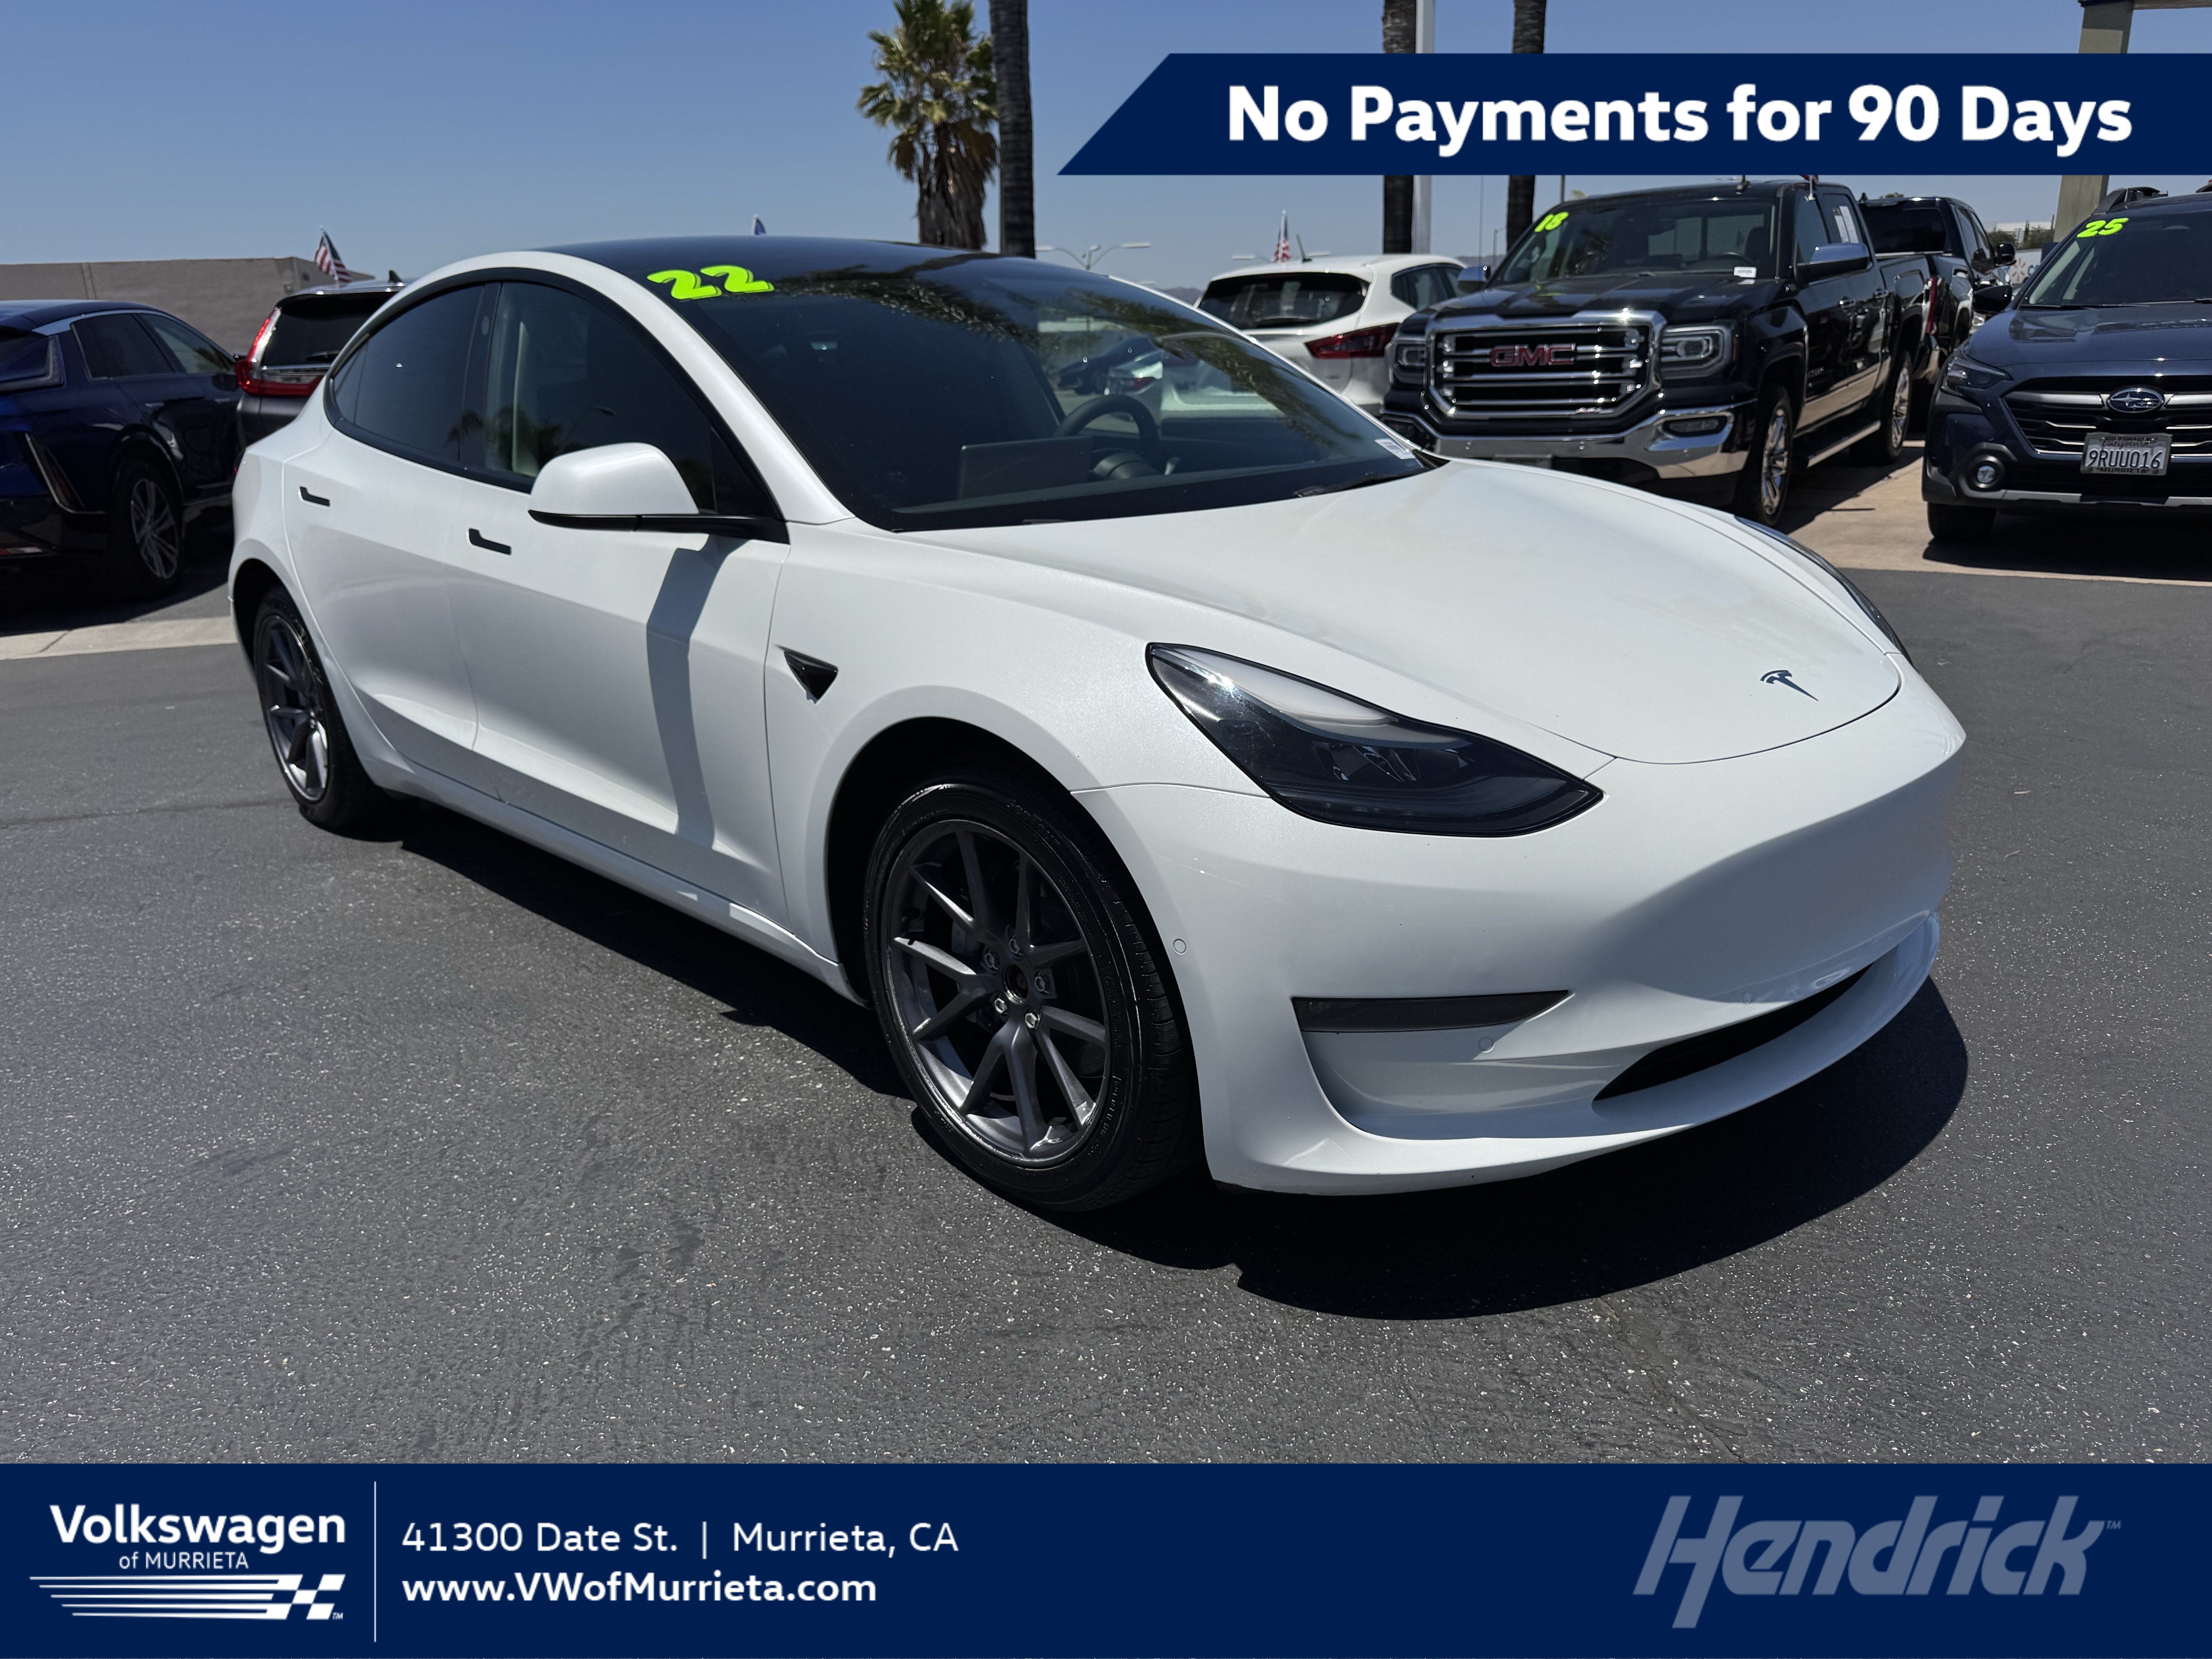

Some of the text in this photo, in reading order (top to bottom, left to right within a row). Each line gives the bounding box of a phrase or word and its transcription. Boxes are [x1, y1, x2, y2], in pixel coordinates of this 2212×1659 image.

[1535, 212, 1568, 232] 18
[2077, 218, 2128, 238] 25
[648, 265, 774, 299] 22
[1491, 343, 1575, 367] GMC
[2087, 450, 2163, 468] 9RUU016
